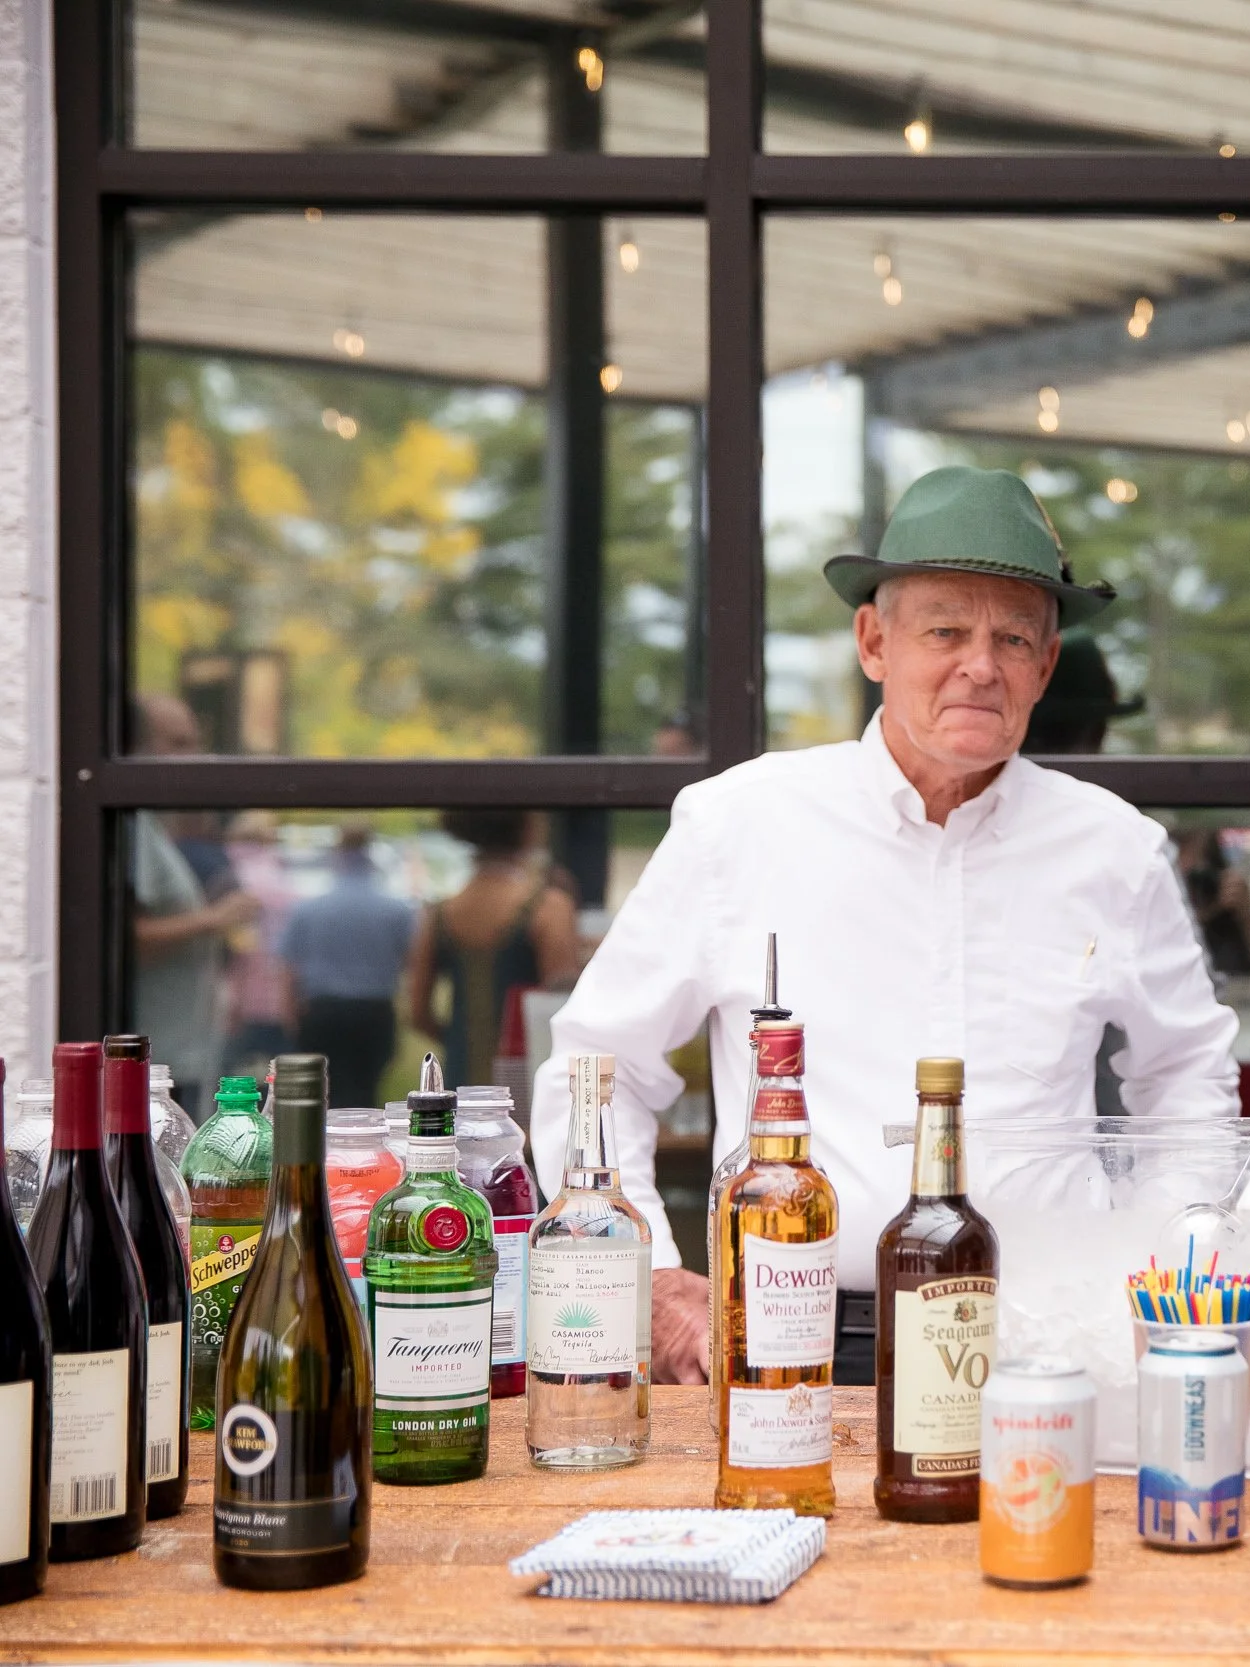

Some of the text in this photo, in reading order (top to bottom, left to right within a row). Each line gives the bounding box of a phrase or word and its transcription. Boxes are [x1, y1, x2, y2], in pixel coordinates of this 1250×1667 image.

[192, 1243, 257, 1290] Schweppe
[756, 1262, 835, 1289] Dewar's
[763, 1299, 832, 1317] White Label
[386, 1336, 484, 1363] Tanqueray
[562, 1340, 592, 1350] Tequila
[411, 1362, 462, 1373] IMPORTED
[921, 1391, 981, 1405] CANADI
[392, 1416, 477, 1431] LONDON DRY GIN
[236, 1426, 257, 1438] KIM
[917, 1457, 968, 1471] CANADA'S
[253, 1511, 288, 1526] Blanc
